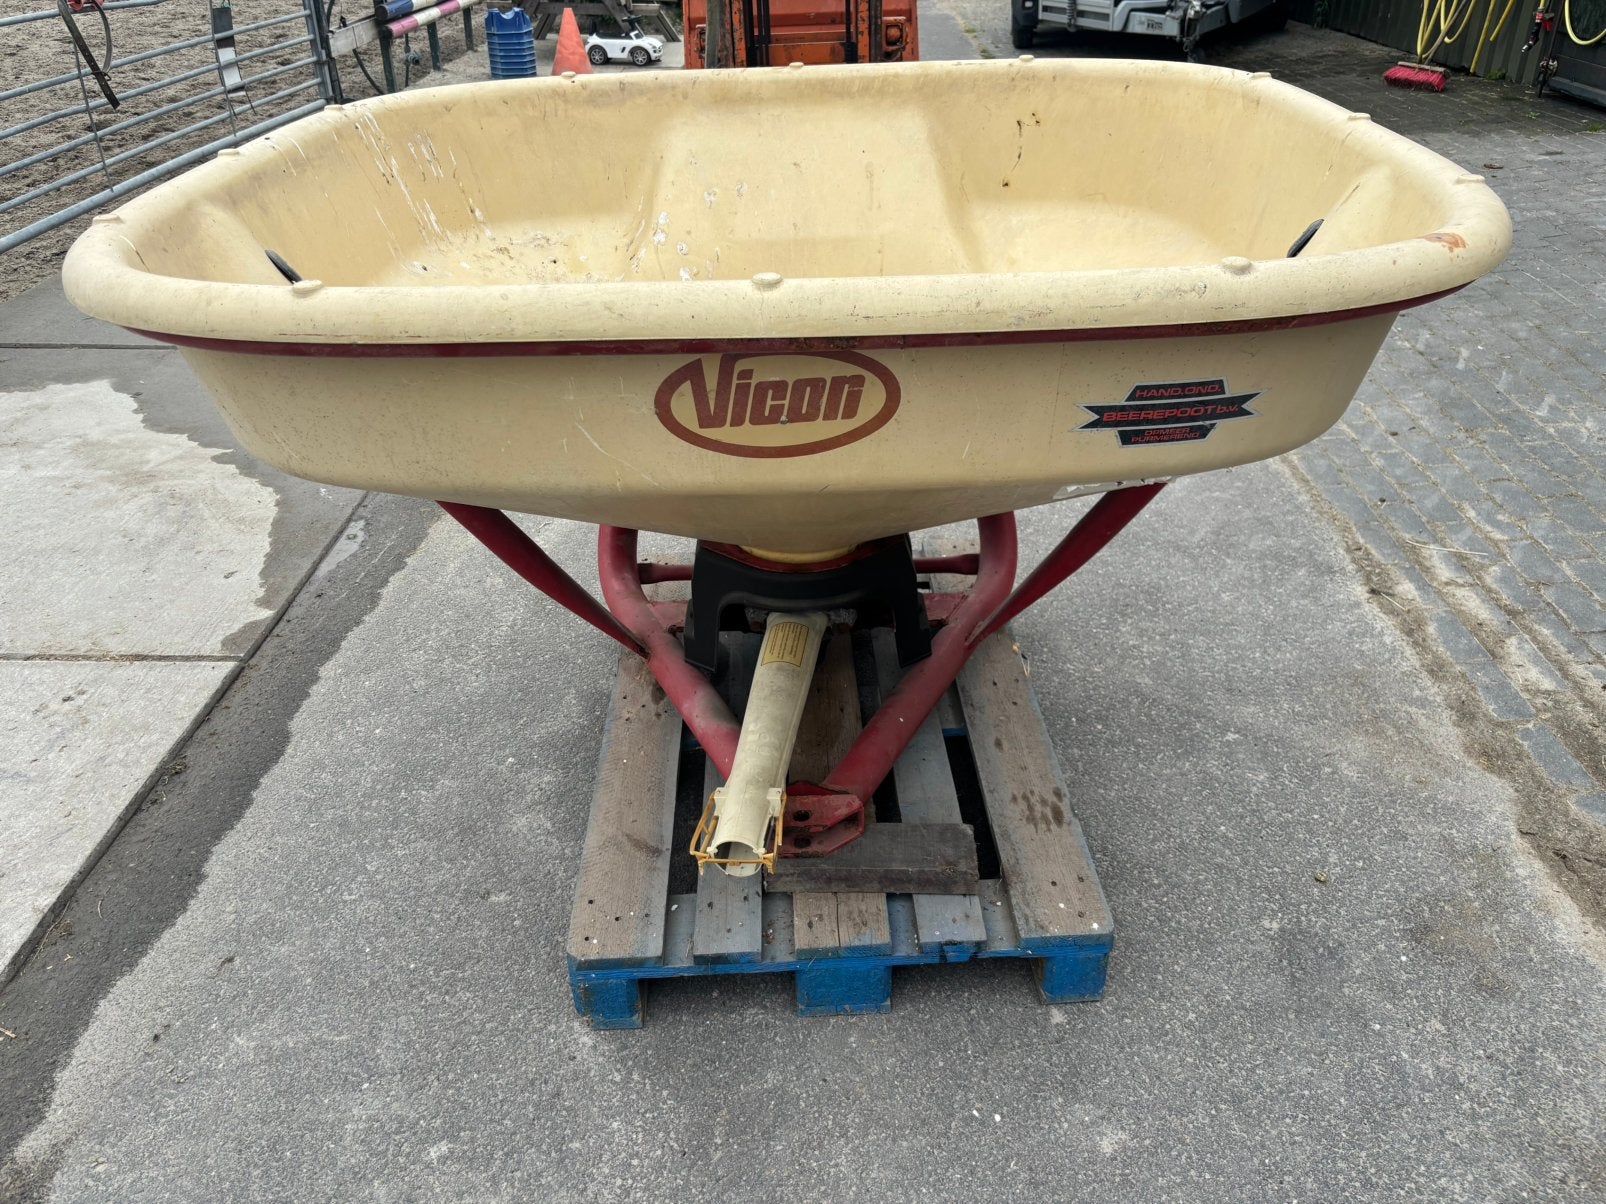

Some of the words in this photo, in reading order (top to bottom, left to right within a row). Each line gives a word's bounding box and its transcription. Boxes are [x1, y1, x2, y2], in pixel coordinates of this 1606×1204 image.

[689, 353, 866, 429] Vicon
[1103, 405, 1216, 422] BEEREPOOT
[1131, 432, 1200, 442] PURMEREND
[1144, 427, 1191, 436] OPMEER
